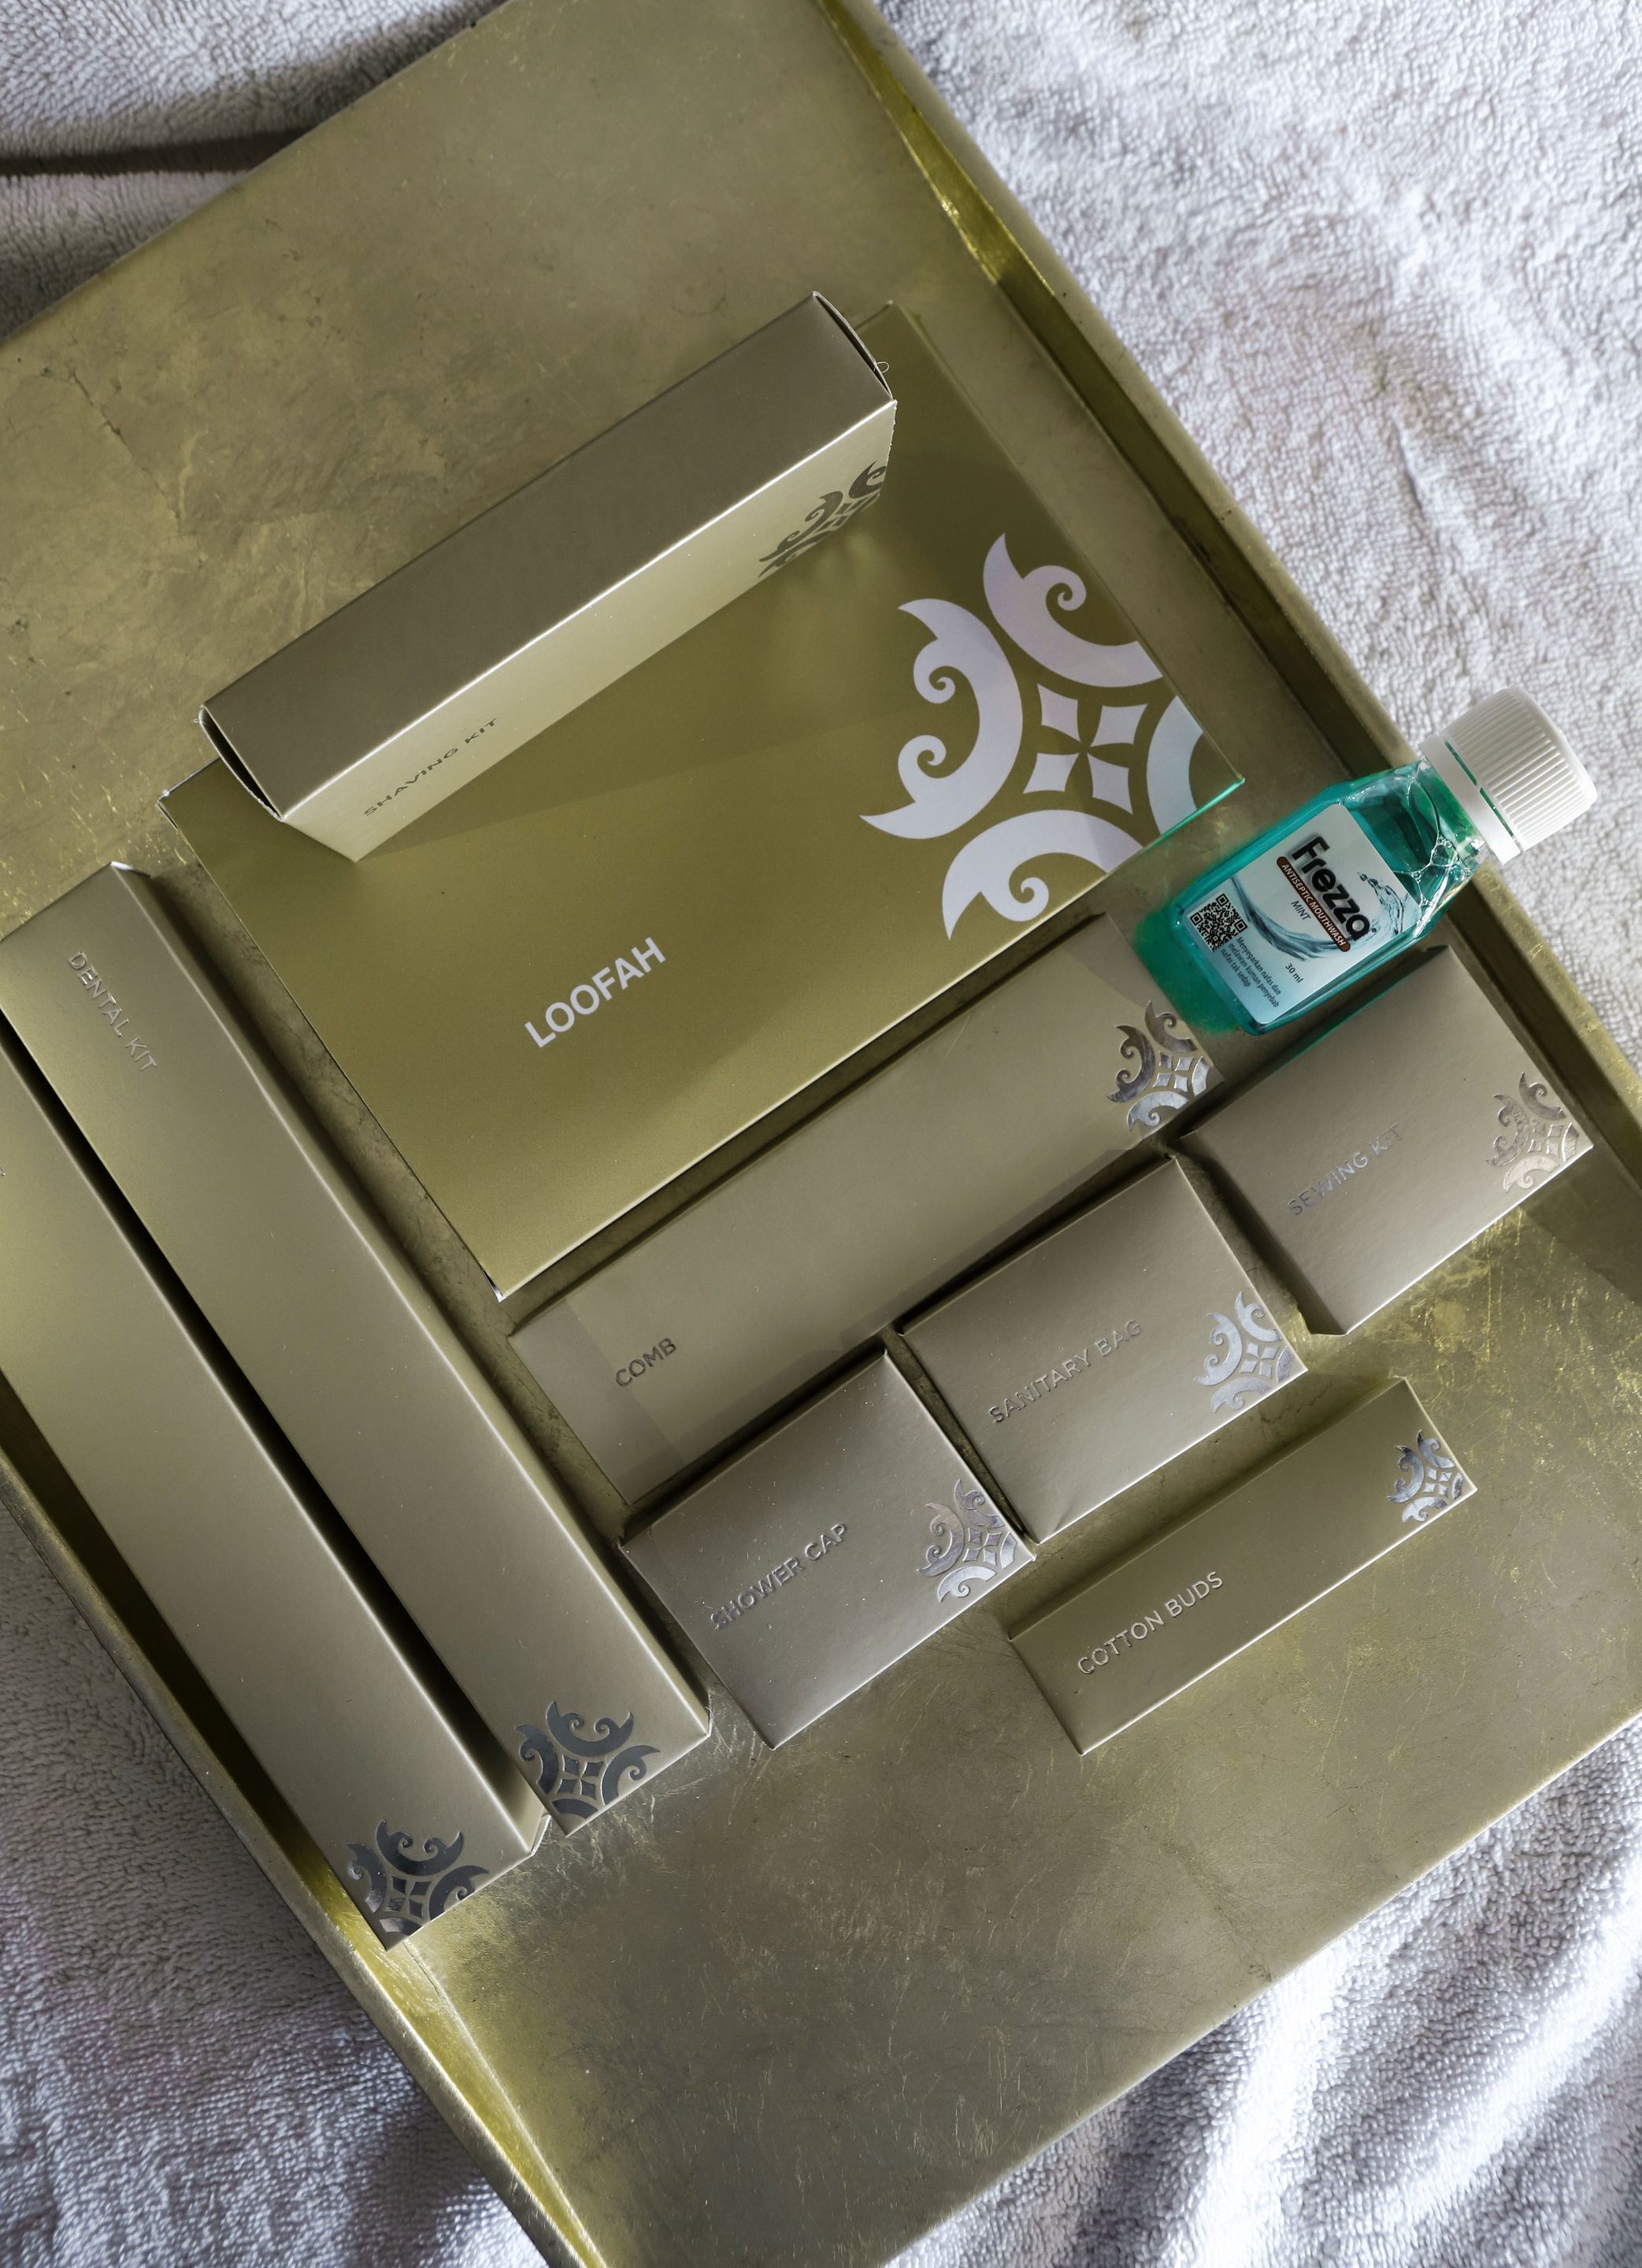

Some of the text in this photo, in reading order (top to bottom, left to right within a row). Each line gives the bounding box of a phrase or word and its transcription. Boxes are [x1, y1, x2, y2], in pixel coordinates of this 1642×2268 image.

[364, 717, 497, 816] SHAVING KIT
[1281, 865, 1346, 946] ANTISEPTIC MOUTHWASH
[1291, 900, 1311, 921] MINT
[1292, 836, 1370, 941] Frezza
[68, 951, 158, 1071] DENTAL KIT
[524, 937, 666, 1048] LOOFAH
[1221, 948, 1251, 988] nafas tak sedap
[1229, 943, 1280, 1008] melawan kuman penyebab
[1236, 937, 1281, 995] Menyegarkan nafas dan
[1285, 962, 1303, 983] 30 ml
[1288, 1122, 1402, 1216] SEWING KIT
[615, 1338, 676, 1387] COMB
[988, 1318, 1142, 1424] SANITARY BAG
[710, 1523, 847, 1629] SHOWER CAP
[1077, 1571, 1223, 1674] COTTON BUDS
